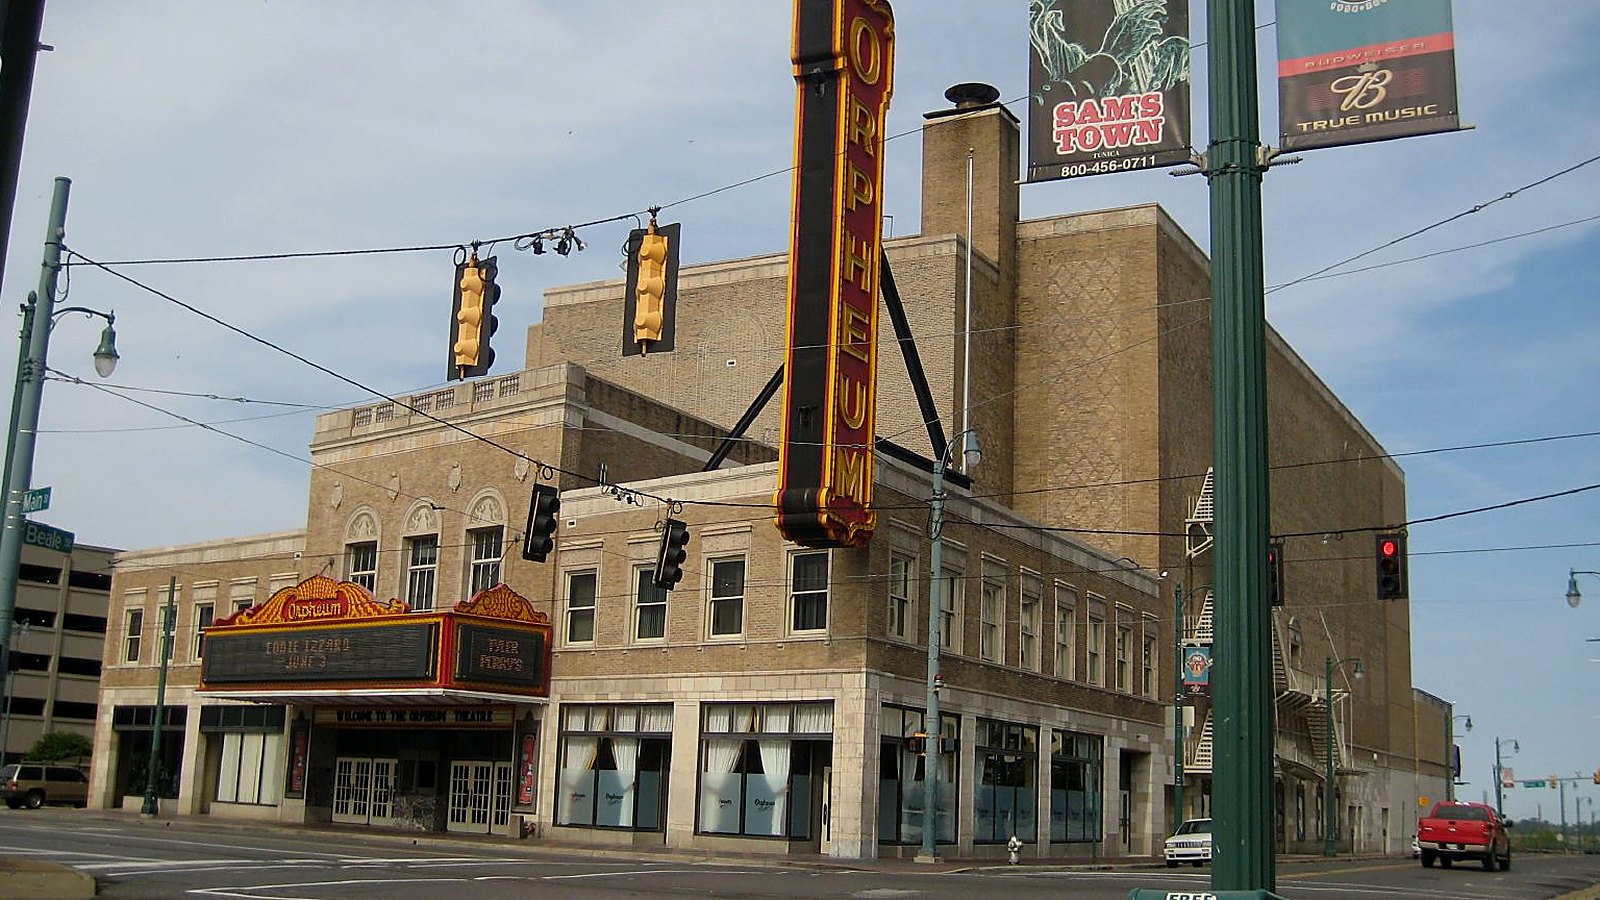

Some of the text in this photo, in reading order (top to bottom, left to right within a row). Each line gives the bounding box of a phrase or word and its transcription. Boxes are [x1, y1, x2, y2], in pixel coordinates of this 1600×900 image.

[1055, 93, 1163, 128] SAM'S
[1297, 104, 1438, 132] TRUE MUSIC
[1055, 118, 1164, 152] TOWN
[1091, 150, 1120, 159] TUNICA
[1060, 156, 1157, 178] 800-456-0711
[836, 15, 880, 506] ORPHEUM
[23, 493, 42, 512] Main
[26, 525, 62, 550] Beale
[287, 601, 342, 620] Orpheum
[375, 710, 387, 722] TO
[391, 710, 407, 722] THE
[455, 710, 493, 722] THEATRE
